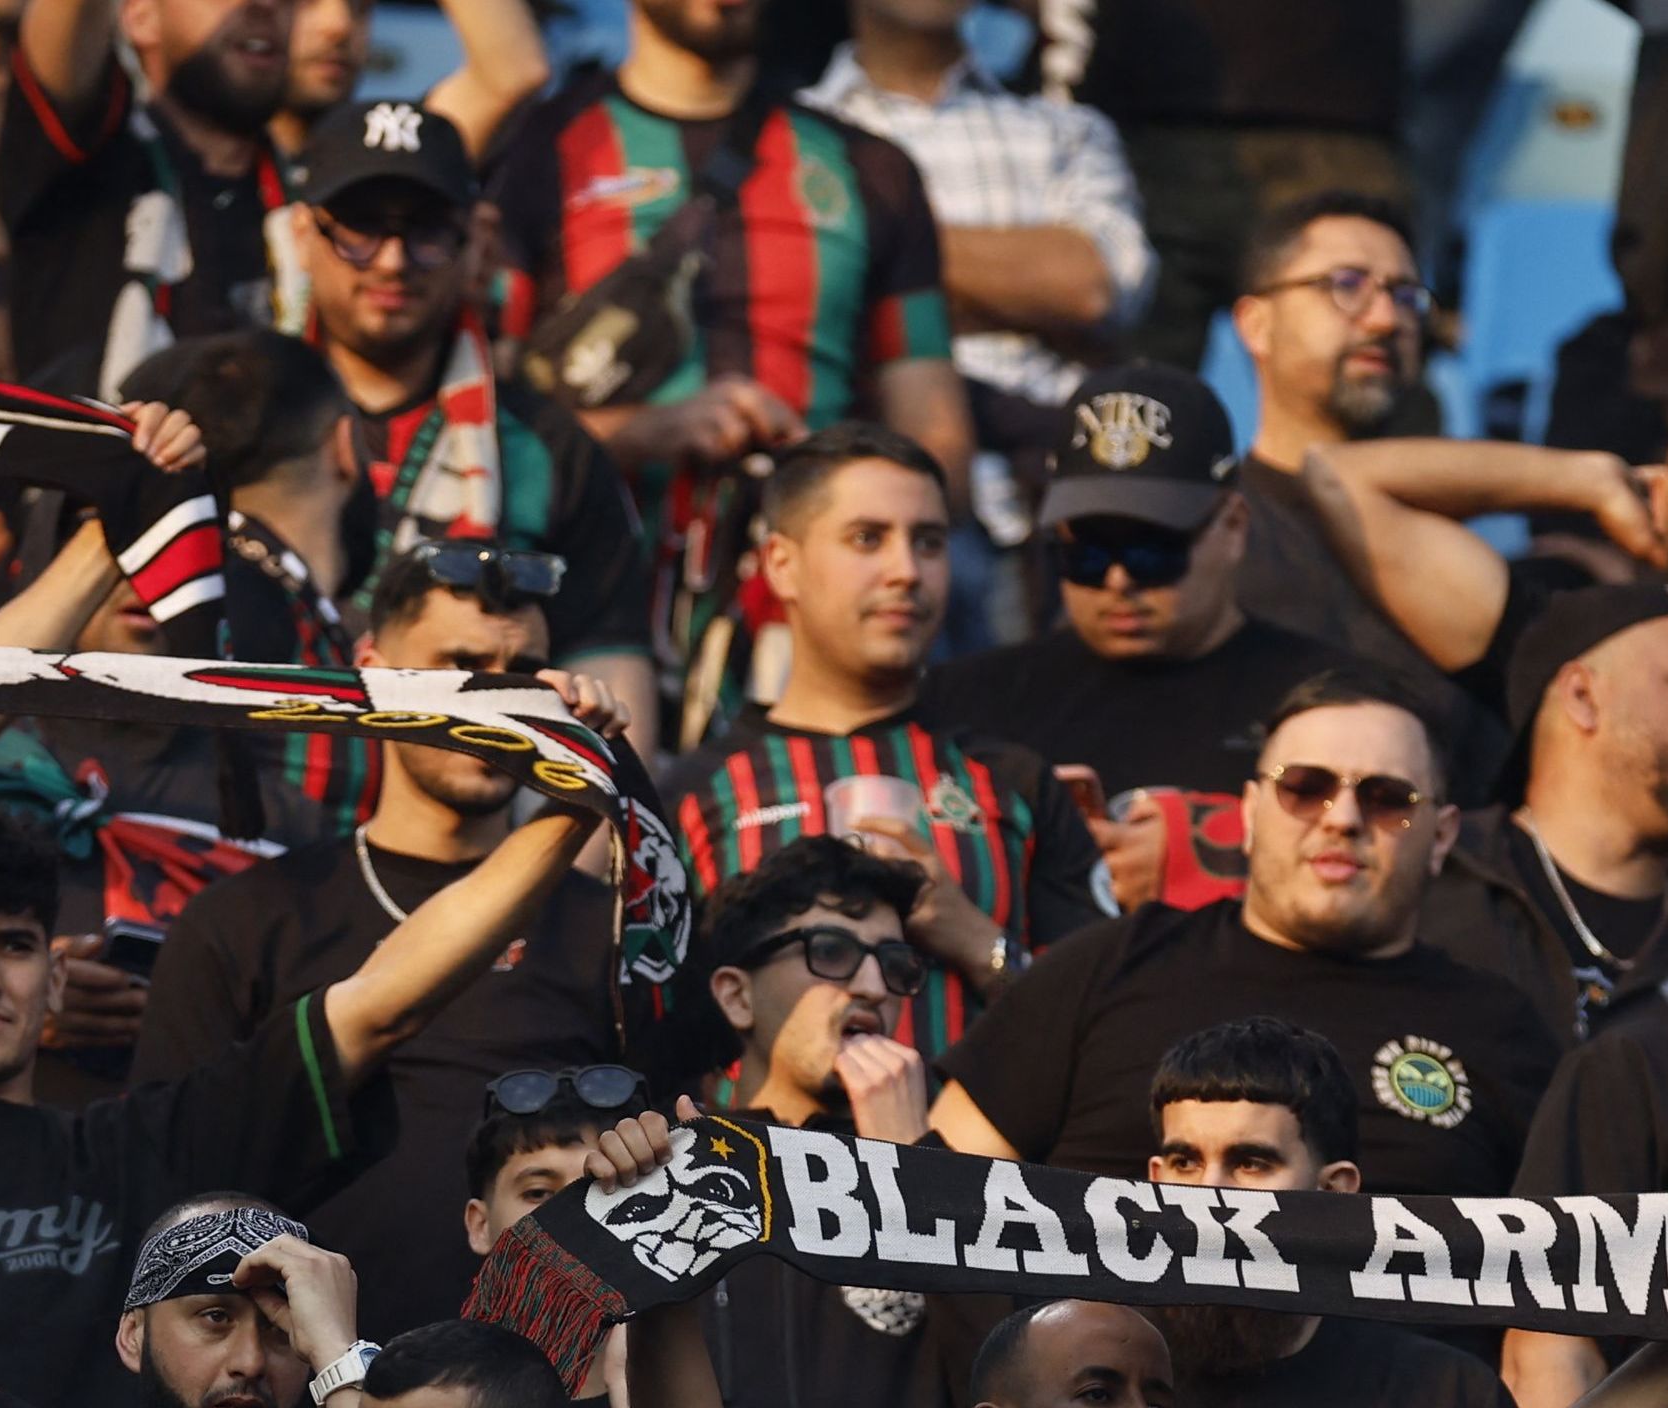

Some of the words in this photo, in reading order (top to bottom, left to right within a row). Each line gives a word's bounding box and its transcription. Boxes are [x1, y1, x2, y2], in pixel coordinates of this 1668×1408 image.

[1071, 391, 1173, 449] NIKE
[247, 698, 589, 791] 2006
[766, 1124, 1300, 1293] BLACK
